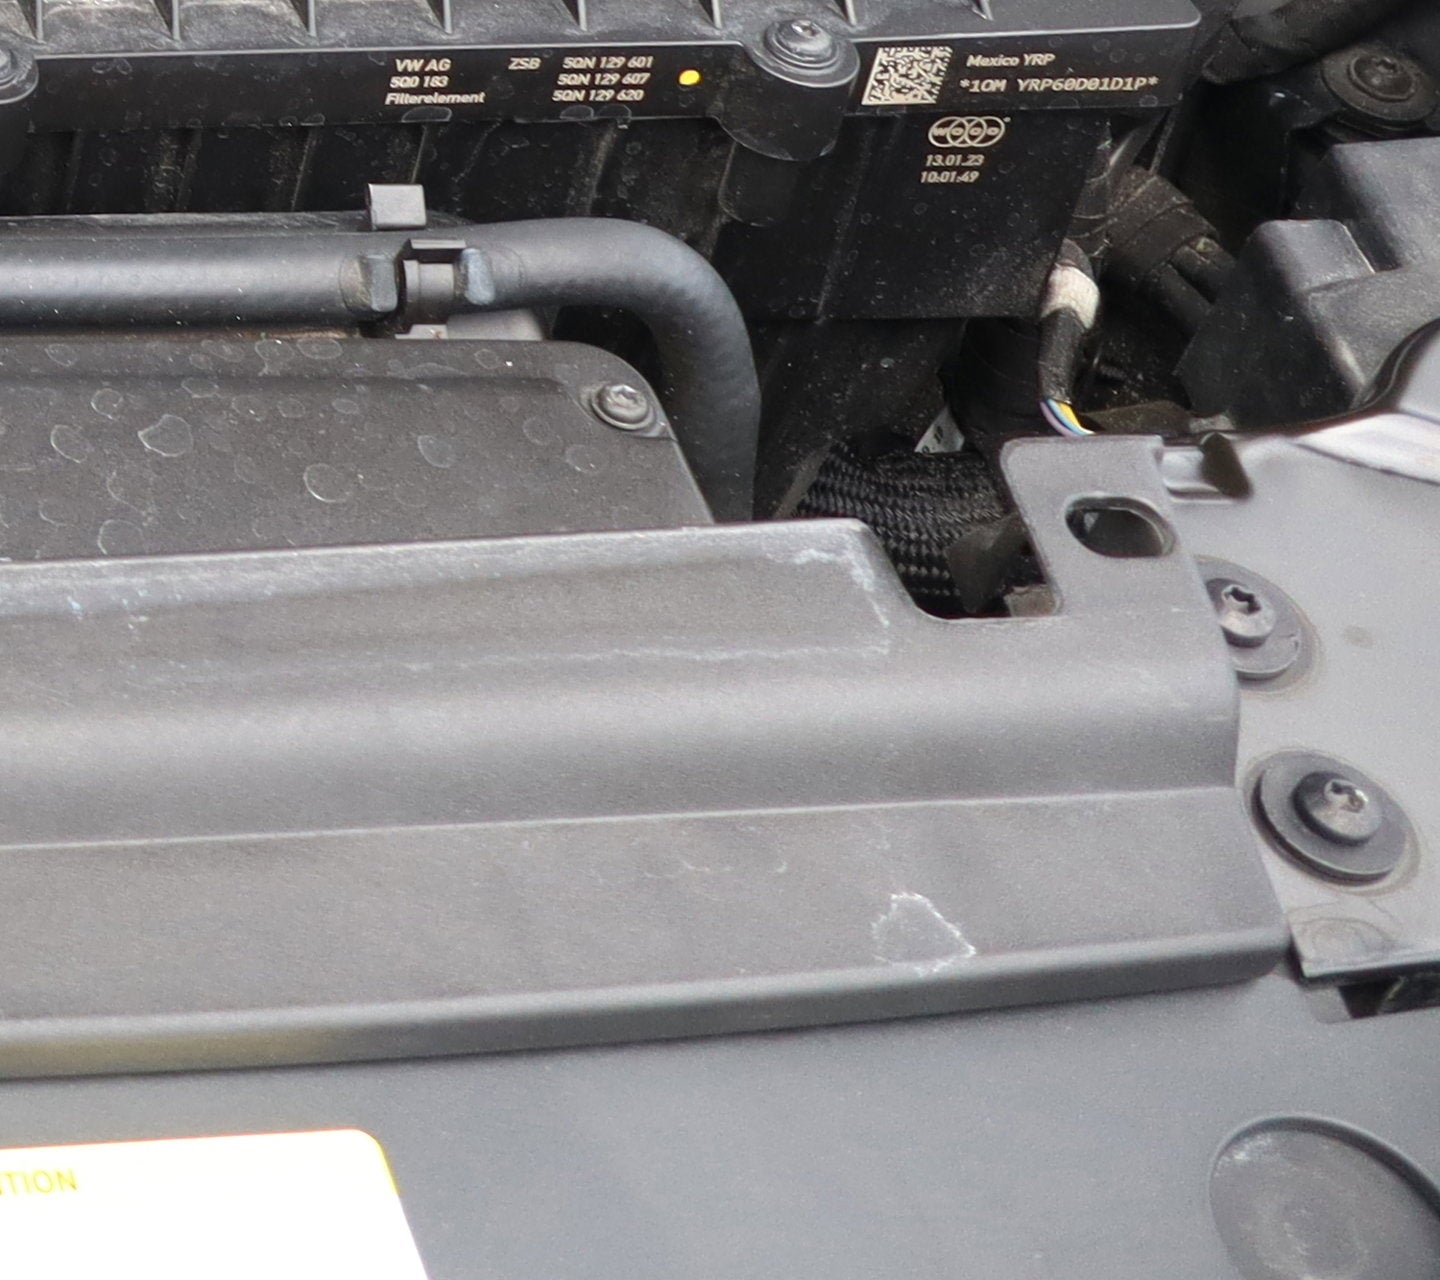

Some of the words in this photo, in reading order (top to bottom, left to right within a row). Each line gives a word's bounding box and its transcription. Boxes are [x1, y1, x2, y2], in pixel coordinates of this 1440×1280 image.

[395, 58, 424, 72] VW
[425, 58, 451, 71] AG
[508, 57, 542, 70] ZSB
[563, 56, 598, 69] 5QN
[599, 56, 626, 69] 129
[627, 55, 654, 68] 601
[966, 54, 1019, 67] Mexico
[1022, 53, 1055, 66] YRP
[422, 76, 449, 88] 183
[557, 73, 592, 86] 5QN
[593, 73, 620, 86] 129
[622, 72, 651, 85] 607
[384, 91, 486, 106] Filterelement
[551, 90, 587, 102] 5QN
[588, 90, 615, 102] 129
[616, 89, 645, 102] 620
[925, 154, 984, 167] 13.01.23
[920, 170, 979, 183] 10:01:49
